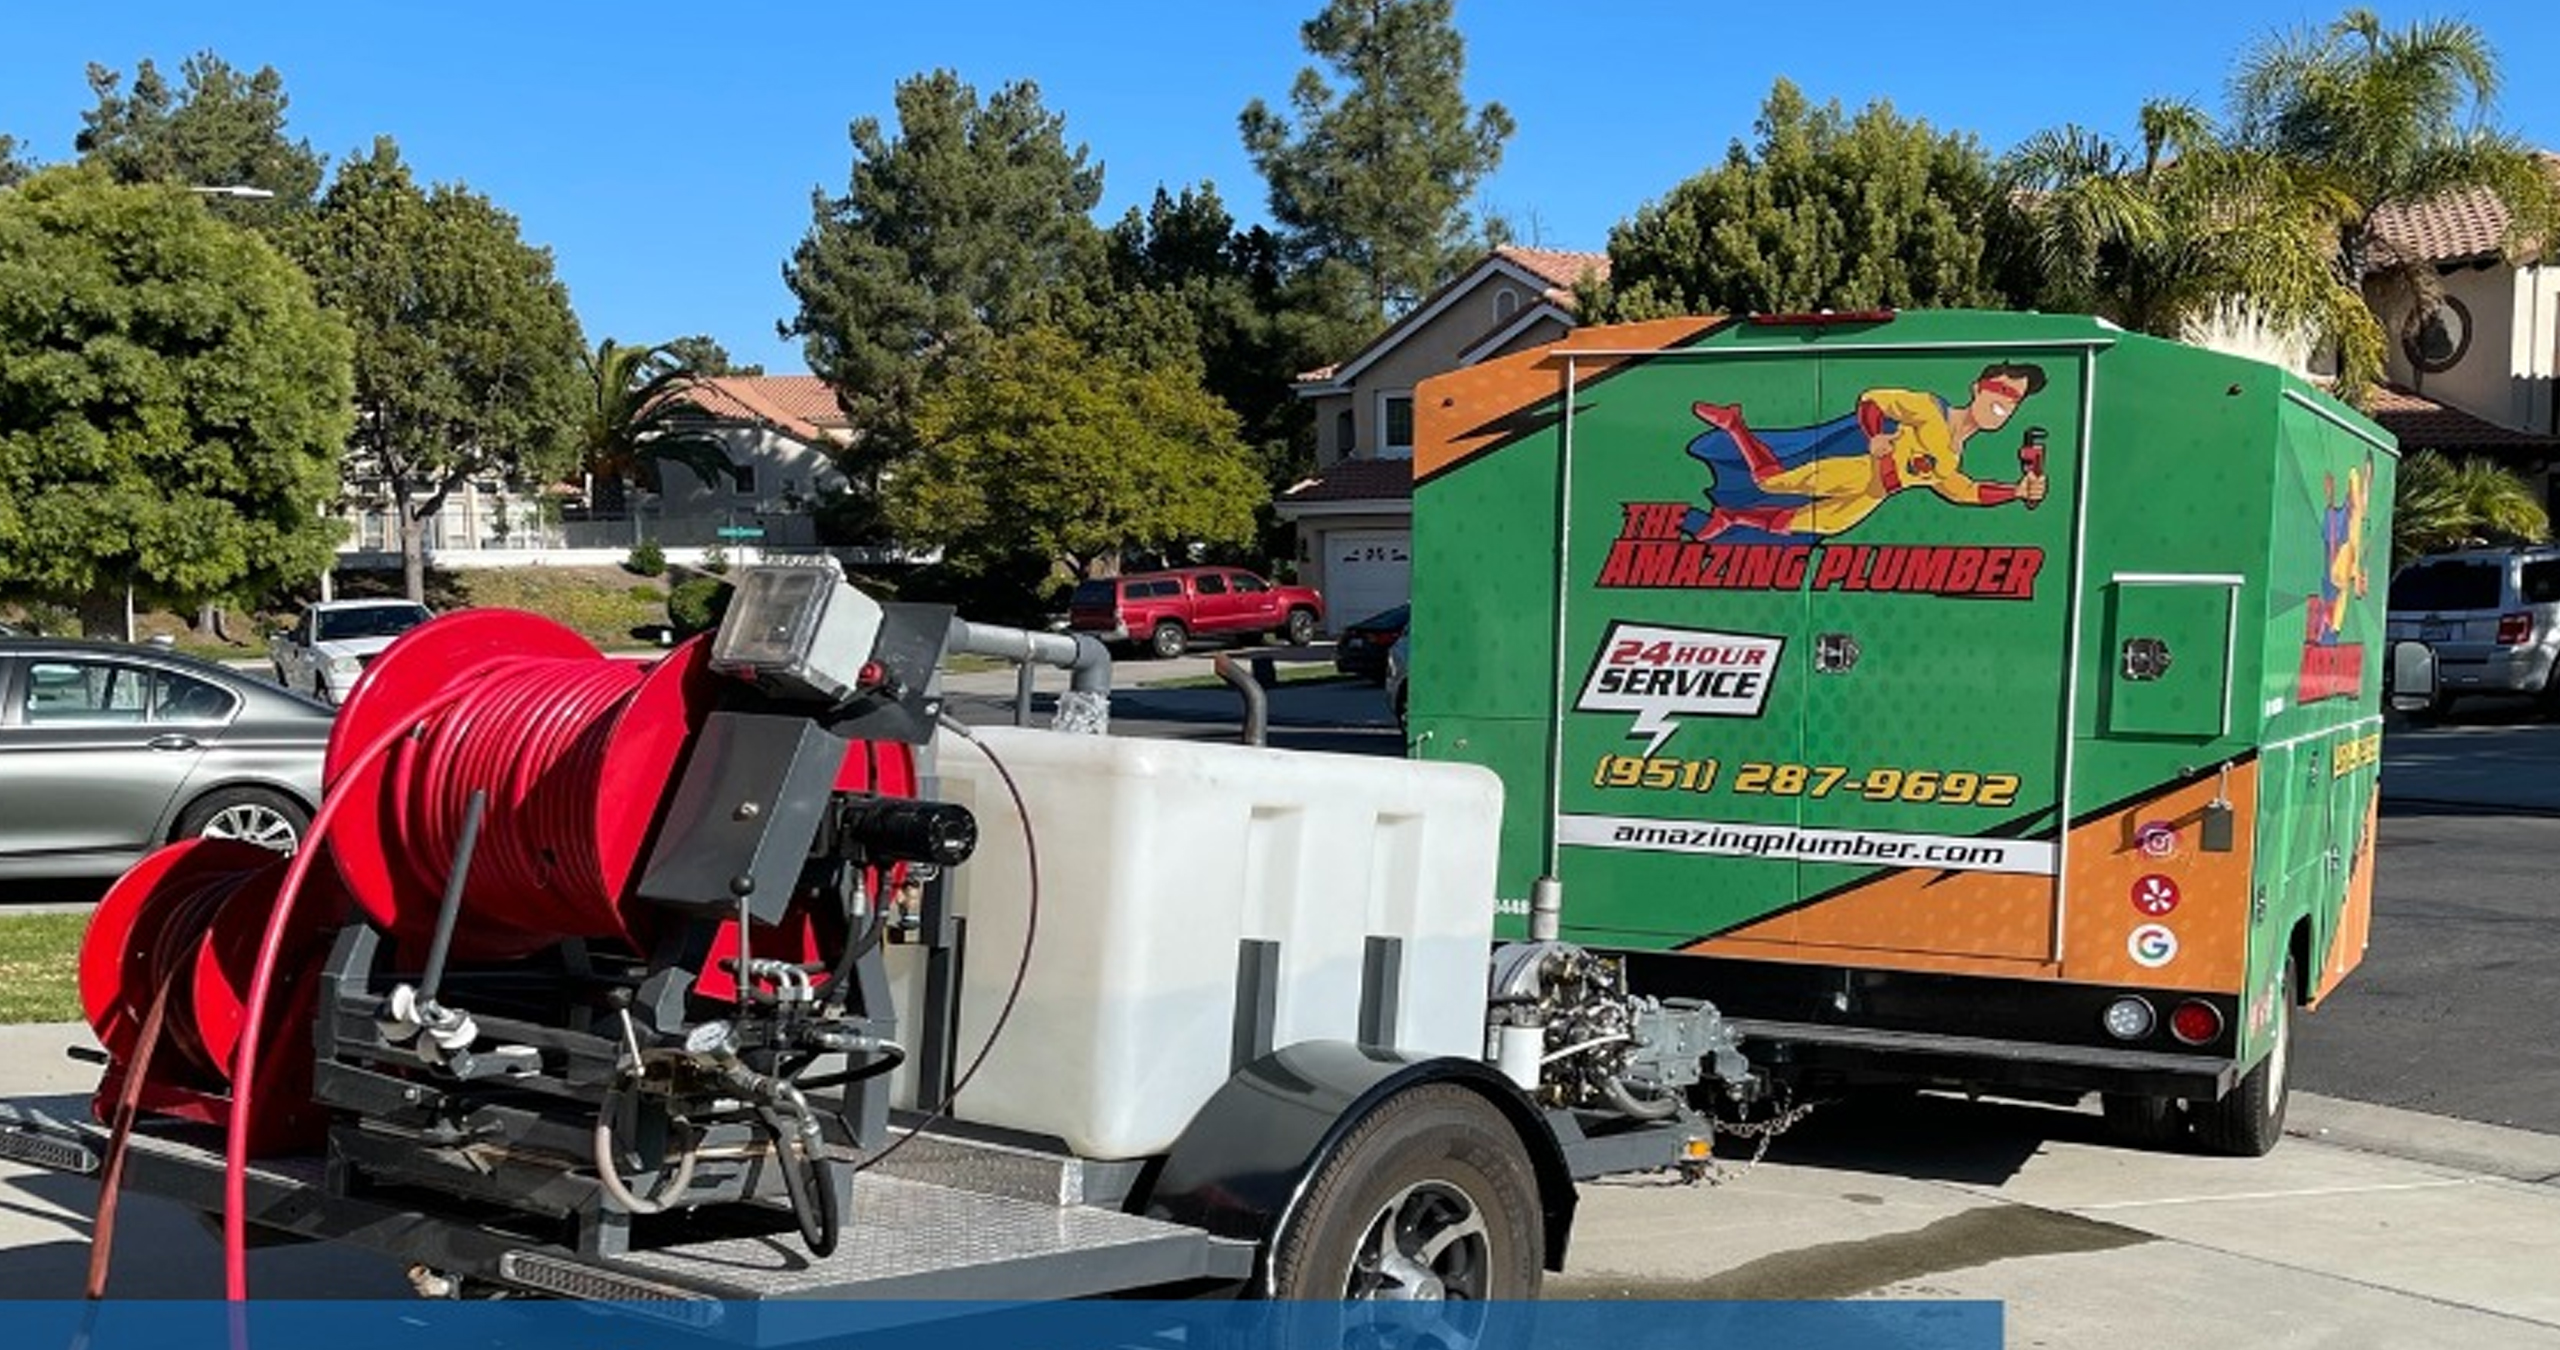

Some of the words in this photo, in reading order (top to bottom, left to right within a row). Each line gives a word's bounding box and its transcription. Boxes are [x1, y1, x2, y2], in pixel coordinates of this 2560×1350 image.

[1621, 502, 1691, 541] THE
[1597, 538, 1808, 591] AMAZING
[1811, 543, 2045, 600] PLUMBER
[1597, 668, 1762, 699] SERVICE
[1593, 754, 1719, 791] (951)
[1733, 761, 2021, 806] 287-9692
[1614, 823, 2004, 864] amazingplumber.com
